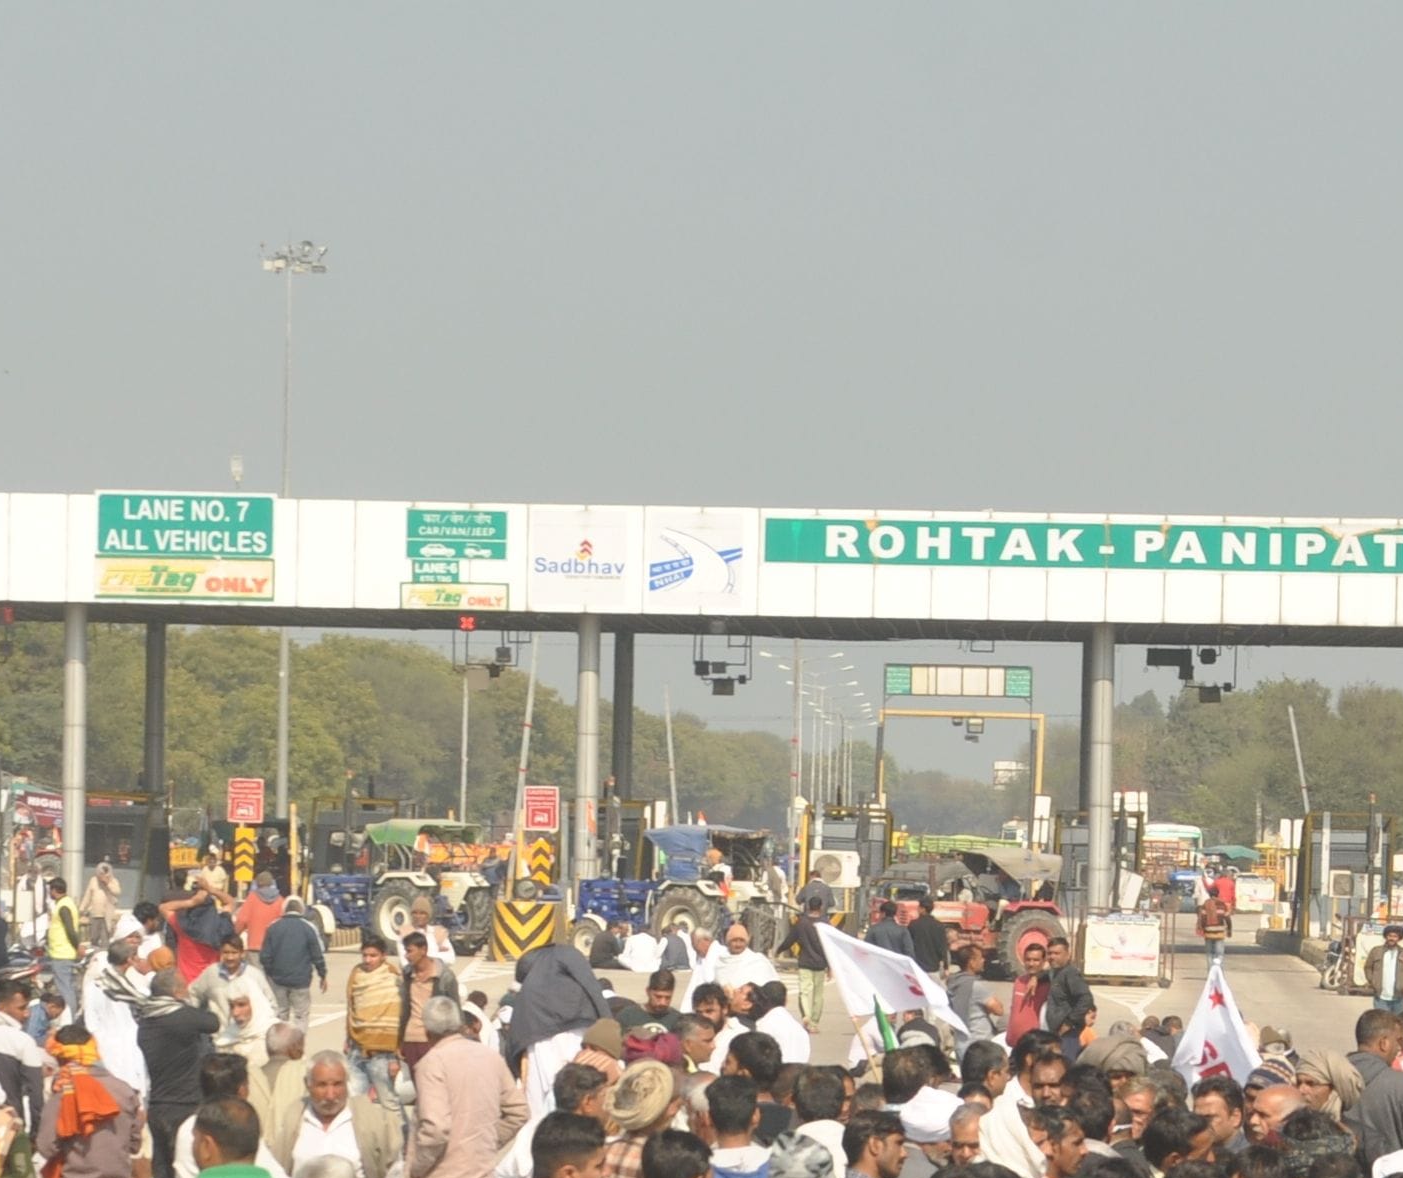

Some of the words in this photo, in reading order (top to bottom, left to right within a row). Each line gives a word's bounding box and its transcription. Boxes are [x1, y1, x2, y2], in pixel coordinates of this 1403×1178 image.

[123, 497, 185, 521] LANE
[190, 499, 230, 523] NO.
[236, 501, 250, 523] 7
[104, 528, 149, 551] ALL
[153, 529, 268, 554] VEHICLES
[534, 557, 626, 575] Sadbhav
[205, 577, 269, 593] ONLY
[467, 597, 504, 608] ONLY
